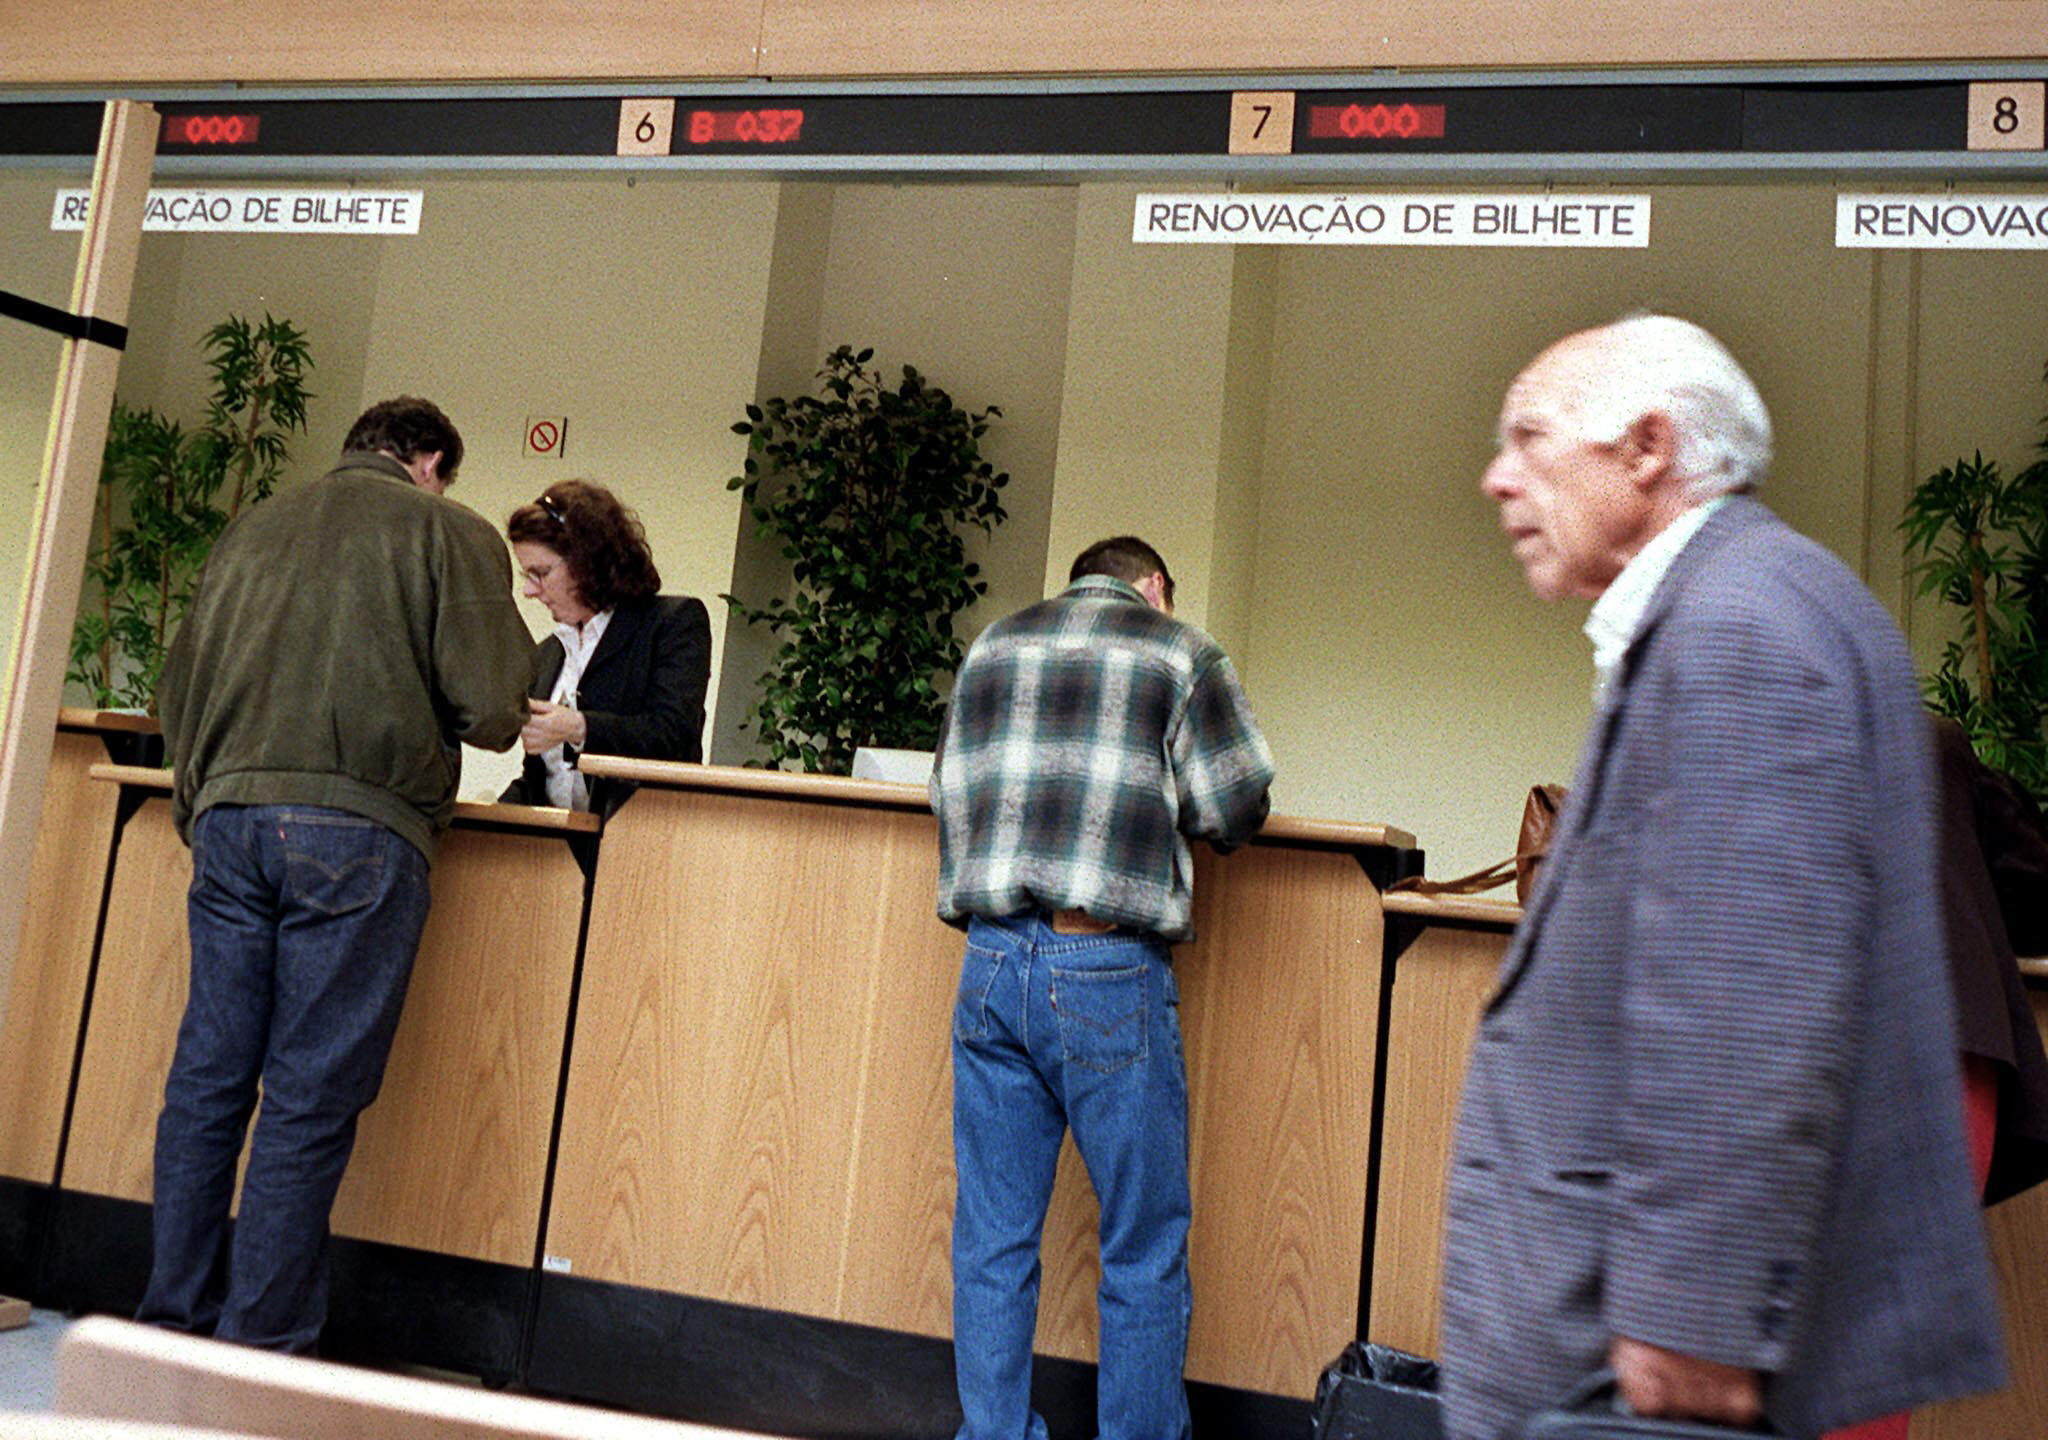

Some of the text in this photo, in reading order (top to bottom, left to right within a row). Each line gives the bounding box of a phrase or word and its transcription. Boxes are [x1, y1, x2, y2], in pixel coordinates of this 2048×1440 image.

[185, 115, 244, 144] 000
[634, 112, 655, 143] 6
[735, 109, 804, 143] 037
[1252, 105, 1273, 139] 7
[1340, 103, 1421, 138] 000
[1992, 96, 2019, 134] 8
[62, 191, 410, 228] REAÇÃO DE BILHETE
[1149, 196, 1635, 240] RENOVAÇÃO DE BILHETE
